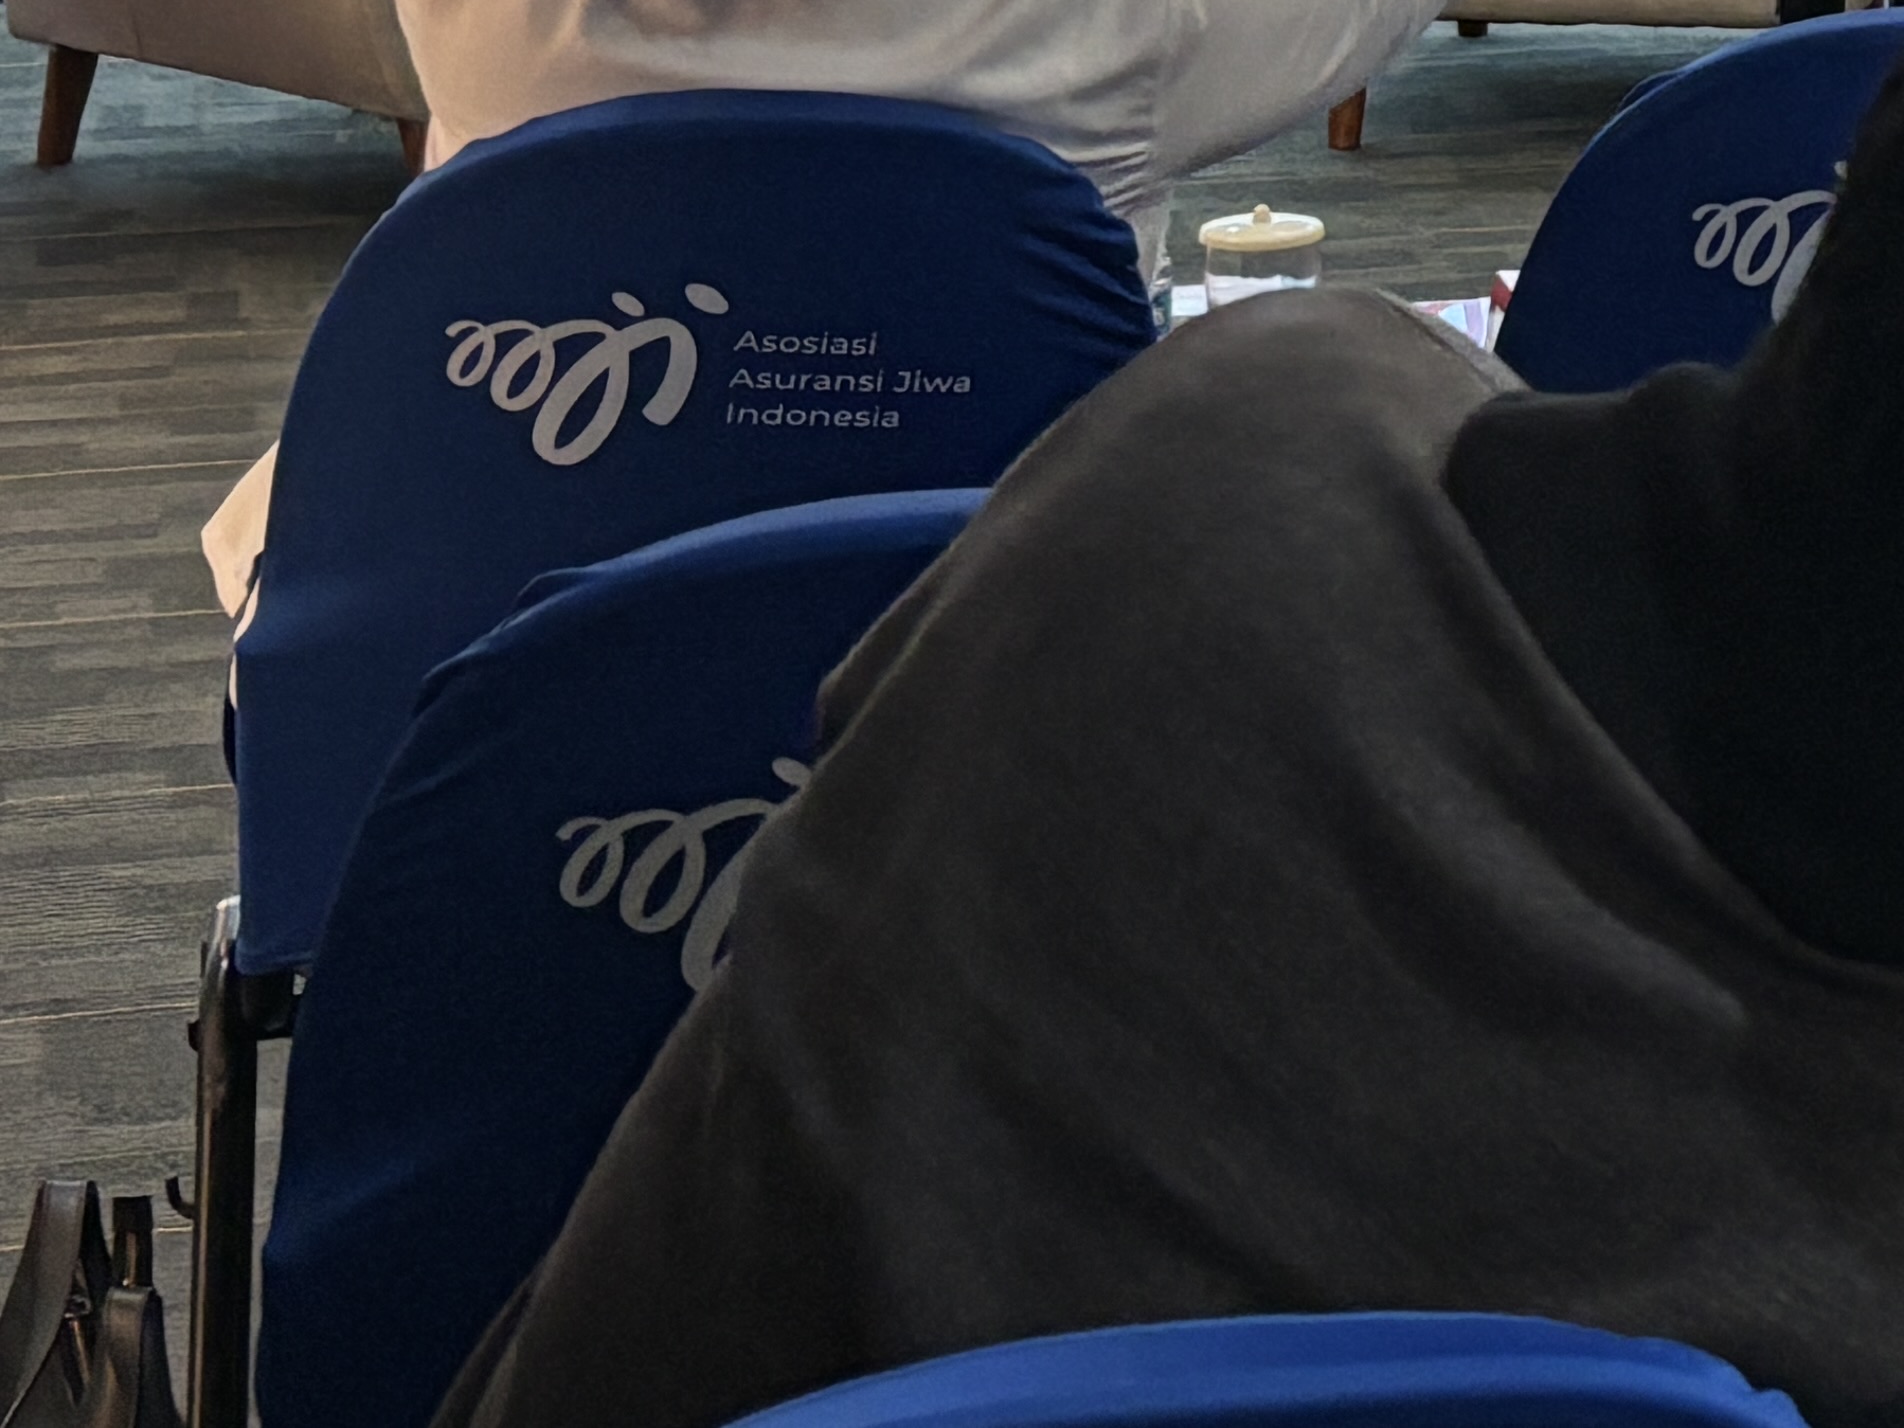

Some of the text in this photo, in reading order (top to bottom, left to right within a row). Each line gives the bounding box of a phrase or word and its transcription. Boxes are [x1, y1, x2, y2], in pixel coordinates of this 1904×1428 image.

[733, 330, 878, 356] Asosiasi
[728, 368, 972, 393] Asuransi Jiwa
[726, 402, 901, 428] Indonesia
